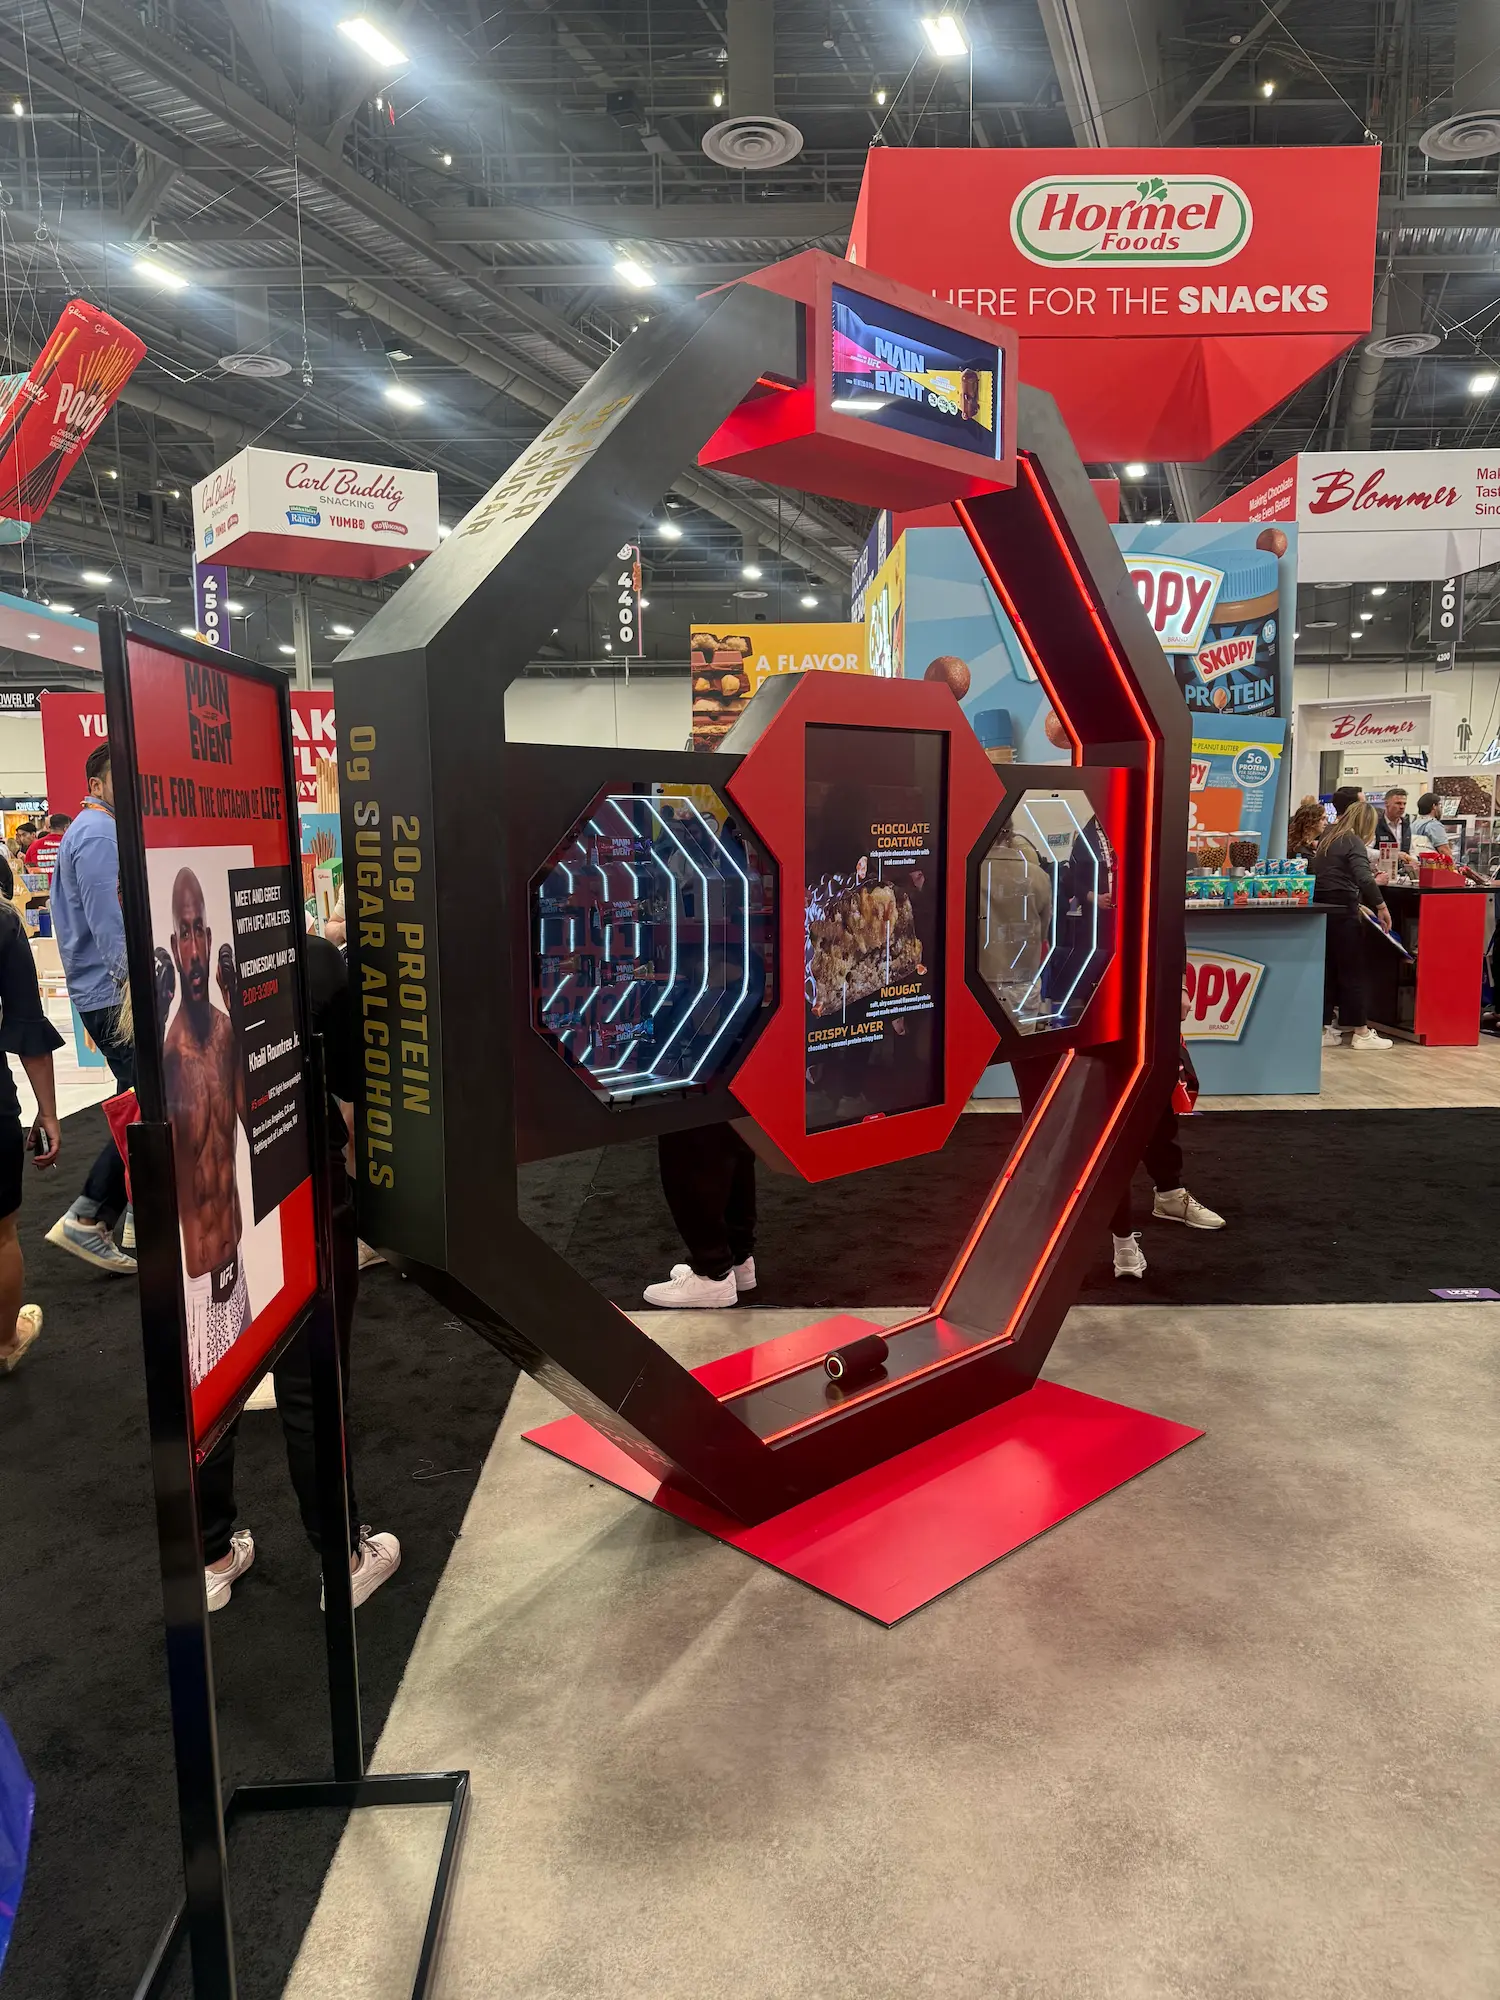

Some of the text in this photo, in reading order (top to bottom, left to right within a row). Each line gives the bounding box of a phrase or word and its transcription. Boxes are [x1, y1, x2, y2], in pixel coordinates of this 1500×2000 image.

[1038, 192, 1224, 231] Hormel
[1101, 233, 1180, 251] Foods
[1029, 287, 1096, 315] FOR
[1107, 287, 1168, 315] THE
[1178, 284, 1328, 314] SNACKS
[68, 305, 89, 323] Glico
[867, 357, 881, 369] UFC
[875, 337, 924, 373] MAIN
[875, 371, 924, 402] EVENT
[285, 462, 404, 511] Carl Buddig
[457, 446, 559, 539] SUGAR
[502, 440, 593, 523] FIBER
[1308, 468, 1462, 515] Blommer
[319, 496, 375, 510] SNACKING
[1249, 476, 1294, 511] Making Chocolate
[291, 513, 317, 524] Ranch
[1262, 506, 1275, 520] Even
[1275, 496, 1291, 513] Better
[203, 575, 220, 645] 4500
[617, 572, 634, 643] 4400
[755, 653, 859, 671] A FLAVOR
[1198, 640, 1255, 675] SKIPPY
[1437, 652, 1450, 662] 4200
[24, 693, 34, 704] UP
[184, 662, 230, 723] MAIN
[1185, 675, 1274, 707] PROTEIN
[1331, 713, 1417, 740] Blommer
[189, 713, 233, 764] EVENT
[1220, 744, 1239, 752] BUTTER
[1239, 764, 1268, 772] PROTEIN
[1246, 753, 1262, 763] 5G
[138, 774, 168, 817] UEL
[169, 777, 197, 817] FOR
[199, 786, 216, 818] THE
[216, 788, 251, 819] OCTAGON
[260, 786, 282, 820] LIFE
[870, 823, 930, 835] CHOCOLATE
[612, 839, 630, 847] MAIN
[877, 836, 923, 848] COATING
[234, 886, 281, 907] MEET AND GREET
[236, 909, 291, 934] WITH UFC ATHLETES
[615, 909, 632, 918] EVENT
[276, 949, 288, 968] MAY
[287, 947, 296, 963] 20
[346, 726, 394, 1189] 0g SUGAR ALCOHOLS
[389, 815, 431, 1115] 20g PROTEIN
[616, 964, 634, 973] MAIN
[880, 983, 922, 998] NOUGAT
[615, 1023, 632, 1032] MAIN
[616, 1032, 633, 1041] EVENT
[807, 1020, 884, 1043] CRISPY LAYER
[266, 1037, 292, 1062] Rountree
[808, 1043, 828, 1052] chocolate
[219, 1261, 234, 1290] UFC
